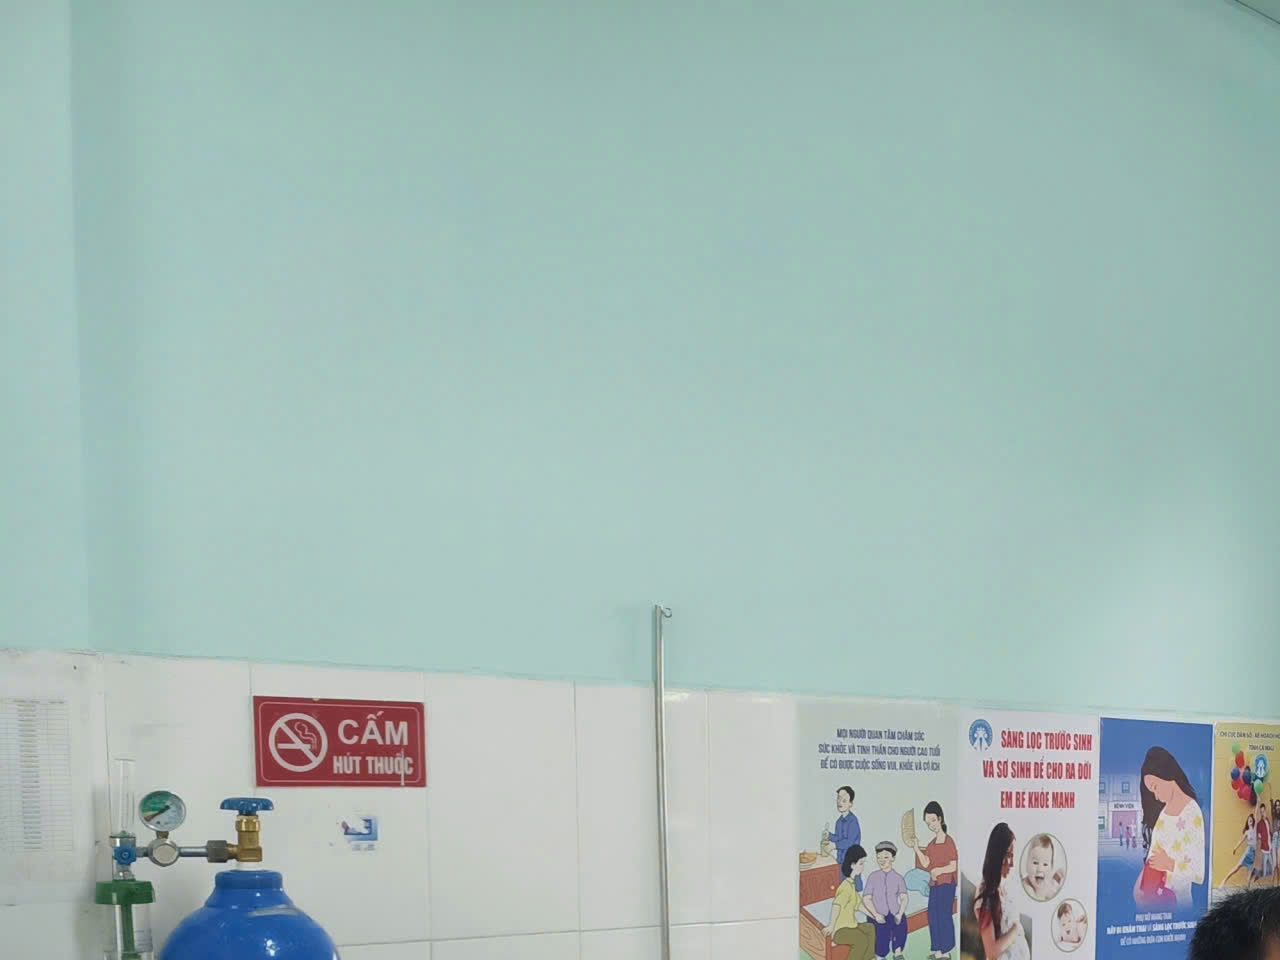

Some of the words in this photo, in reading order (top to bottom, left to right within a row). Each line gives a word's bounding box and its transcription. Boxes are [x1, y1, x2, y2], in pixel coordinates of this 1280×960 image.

[338, 710, 408, 745] CẤM
[849, 728, 866, 739] NGƯỜI
[867, 729, 882, 739] QUAN
[884, 728, 896, 739] TÂM
[857, 745, 870, 754] TINH
[887, 746, 898, 755] CHO
[1001, 728, 1024, 748] SÀNG
[1026, 731, 1041, 752] LỌC
[1044, 731, 1071, 750] TRƯỚC
[1073, 734, 1092, 750] SINH
[333, 752, 362, 774] HÚT
[365, 751, 413, 774] THUỐC
[982, 757, 994, 778] VÀ
[997, 759, 1008, 778] SƠ
[1011, 761, 1031, 778] SINH
[1034, 755, 1044, 779] ĐỂ
[1046, 762, 1063, 779] CHO
[1065, 763, 1075, 780] RA
[1078, 761, 1091, 780] ĐỜI
[1001, 791, 1012, 808] EM
[1028, 787, 1049, 808] KHỎE
[1052, 792, 1075, 811] MẠNH
